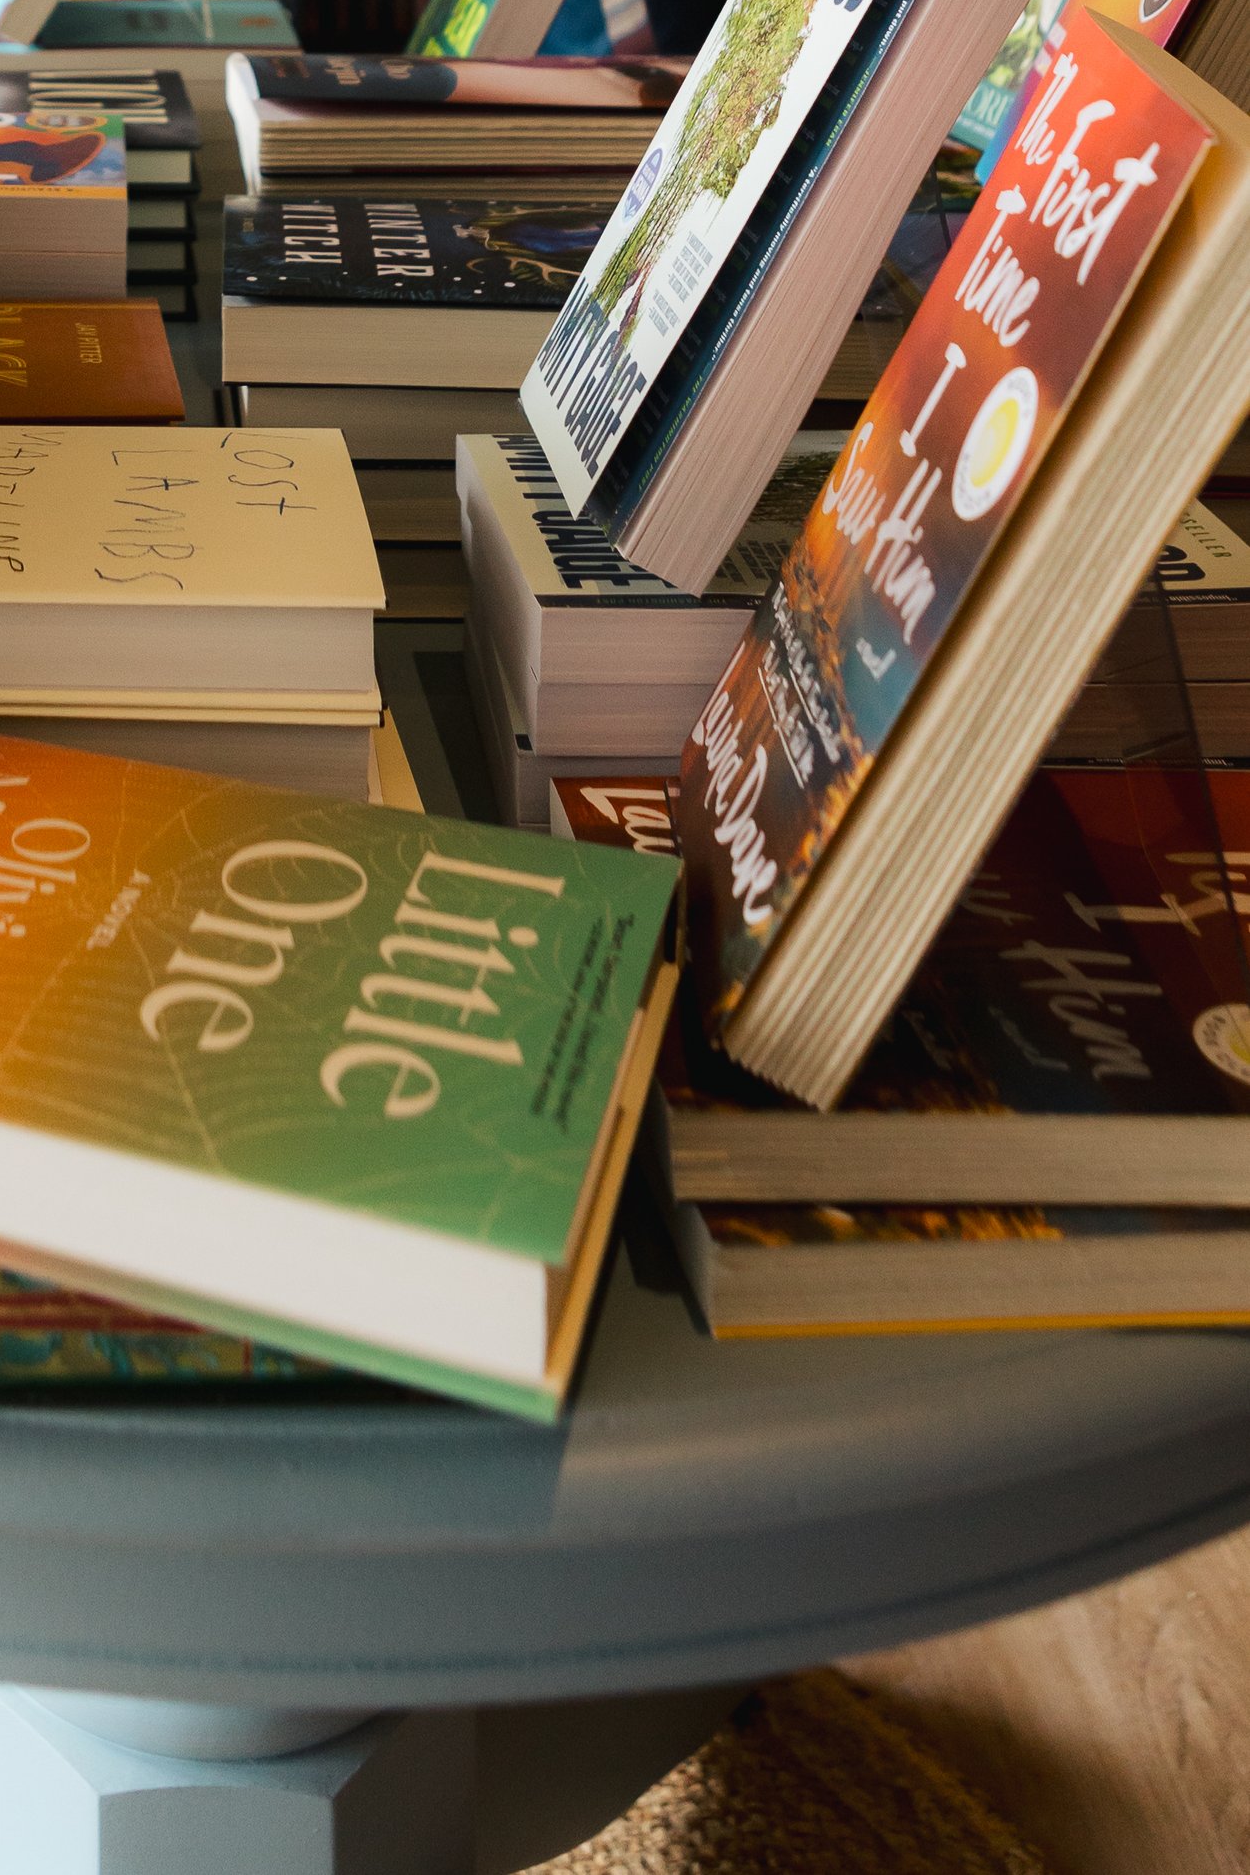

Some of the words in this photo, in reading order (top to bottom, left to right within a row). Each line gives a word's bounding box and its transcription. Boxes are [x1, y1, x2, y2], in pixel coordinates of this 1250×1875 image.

[1014, 51, 1078, 167] The
[281, 203, 343, 265] WITCH
[363, 203, 436, 278] WINTER
[1030, 99, 1159, 286] First
[953, 183, 1041, 347] Time
[76, 322, 100, 336] JAY
[78, 336, 103, 364] PITTER
[536, 278, 606, 410] AMITY
[563, 328, 646, 480] GAIGE
[900, 341, 967, 458] I
[97, 447, 199, 593] LAMBS
[822, 421, 884, 545] Saw
[864, 460, 942, 644] Him
[1180, 512, 1232, 559] SELLER
[580, 785, 680, 857] Lau
[715, 744, 777, 925] Dave
[85, 885, 143, 950] NOVEL
[139, 837, 369, 1054] One
[317, 846, 567, 1121] Little
